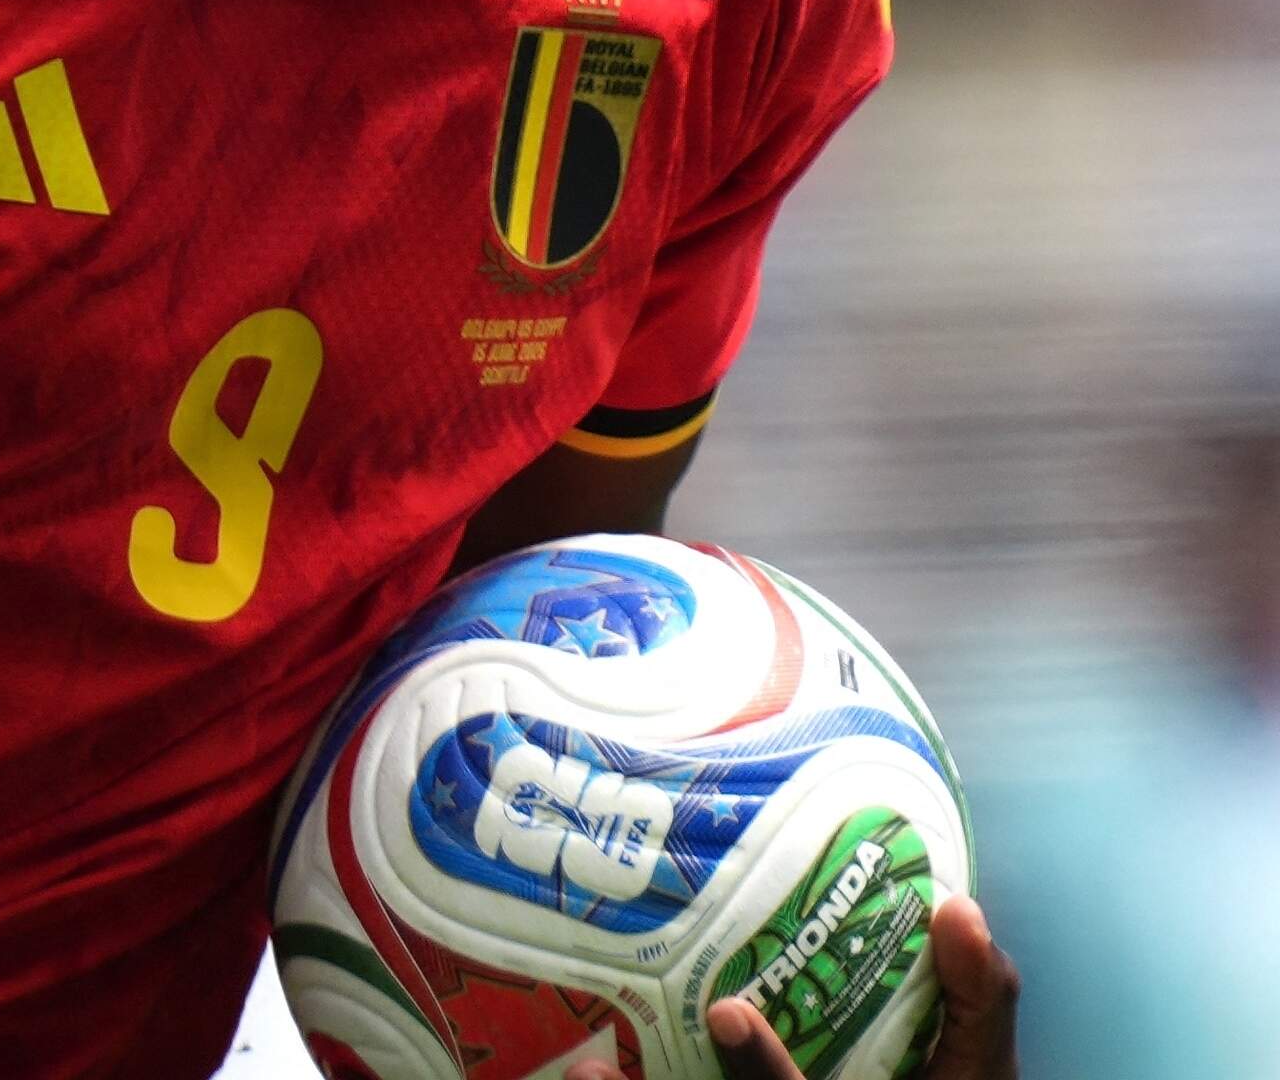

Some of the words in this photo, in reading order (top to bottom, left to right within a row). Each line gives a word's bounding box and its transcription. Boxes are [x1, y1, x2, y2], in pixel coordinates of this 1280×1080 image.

[128, 307, 324, 623] 9
[619, 817, 653, 868] FIFA
[734, 839, 887, 1011] TRIONDA
